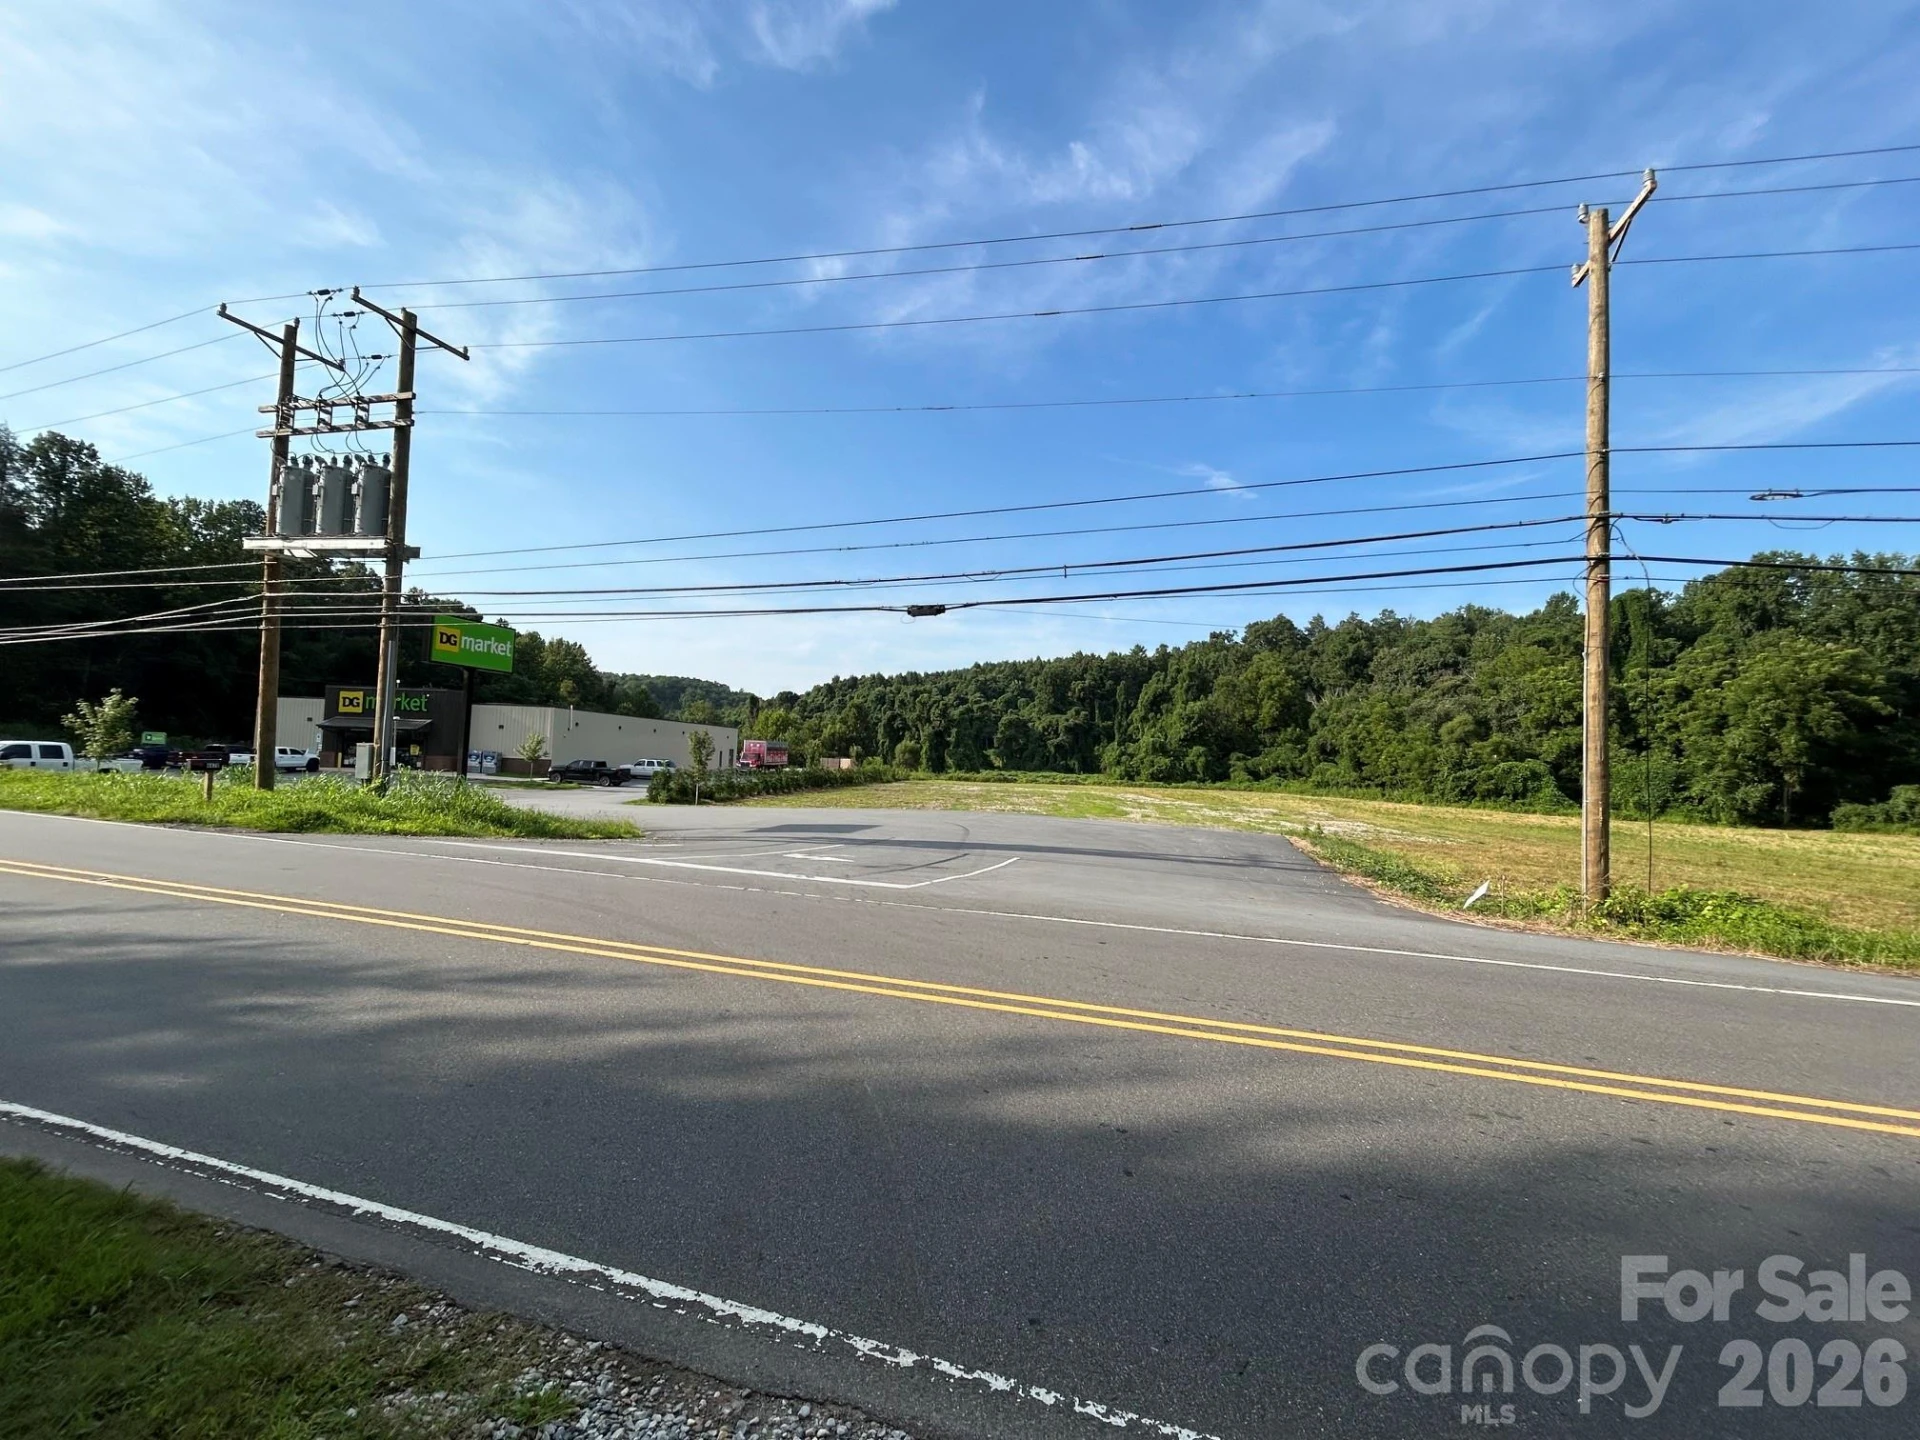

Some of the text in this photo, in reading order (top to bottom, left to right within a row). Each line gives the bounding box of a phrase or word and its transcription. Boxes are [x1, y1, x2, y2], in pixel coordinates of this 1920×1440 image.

[439, 631, 512, 657] DG market
[342, 692, 428, 712] DG mrket
